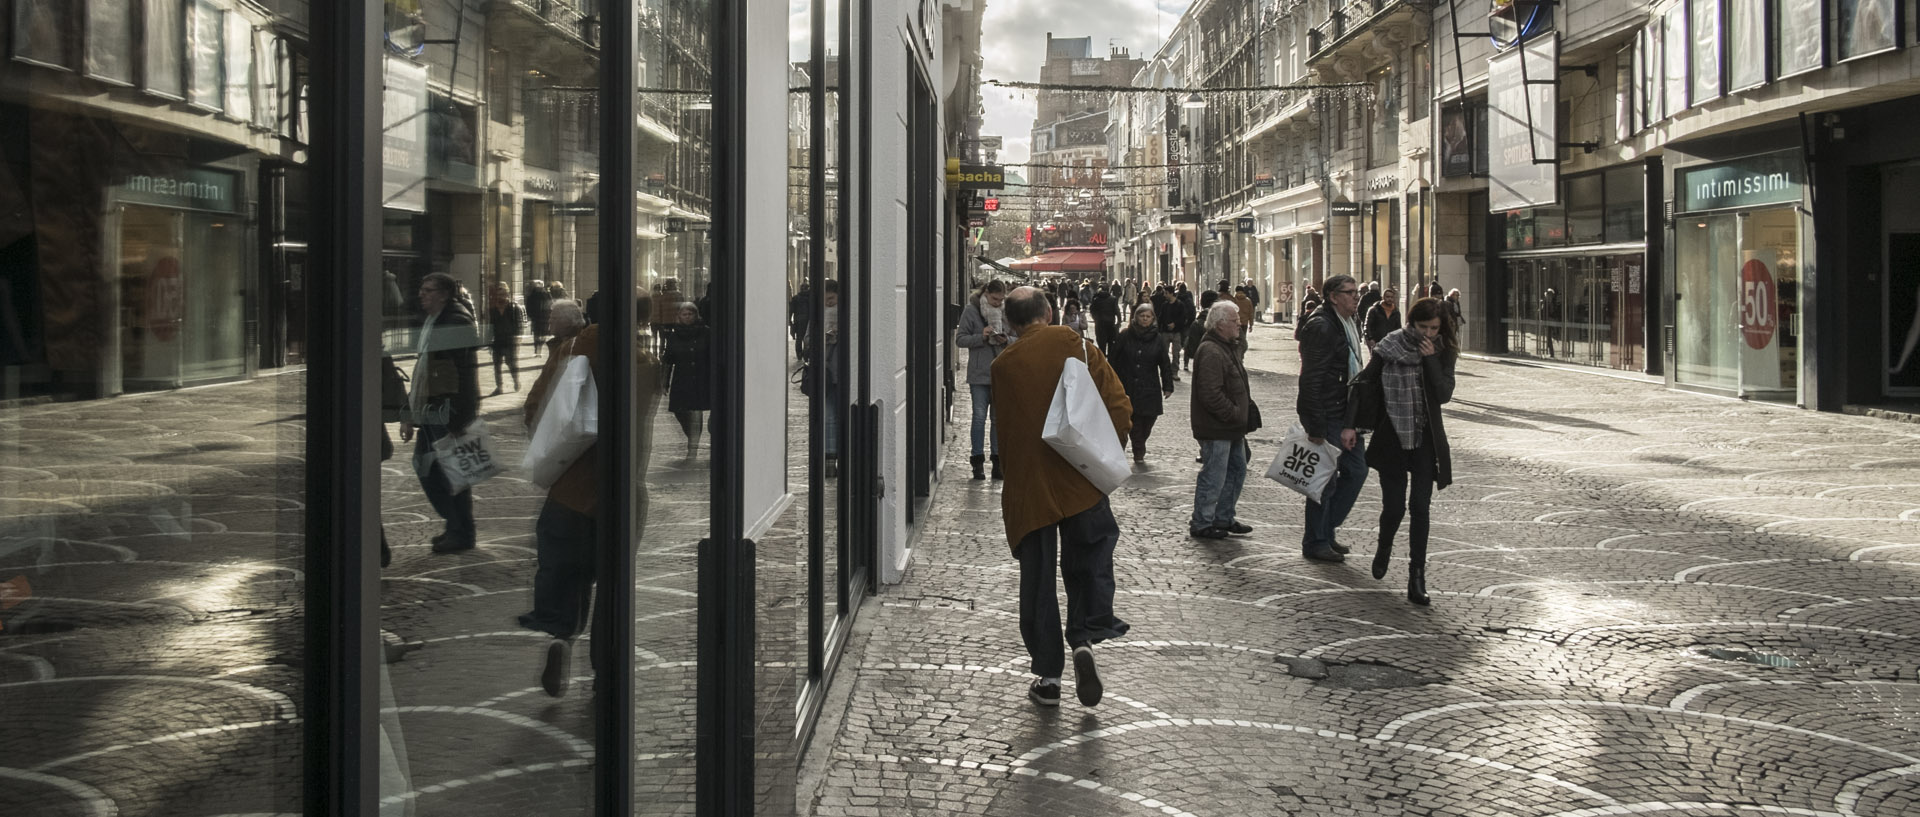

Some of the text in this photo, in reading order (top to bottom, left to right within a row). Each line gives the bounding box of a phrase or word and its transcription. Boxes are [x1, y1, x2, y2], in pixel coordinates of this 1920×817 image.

[959, 171, 1002, 182] sacha
[1697, 172, 1789, 200] intimissimi
[1292, 443, 1320, 466] we
[1283, 455, 1315, 478] are
